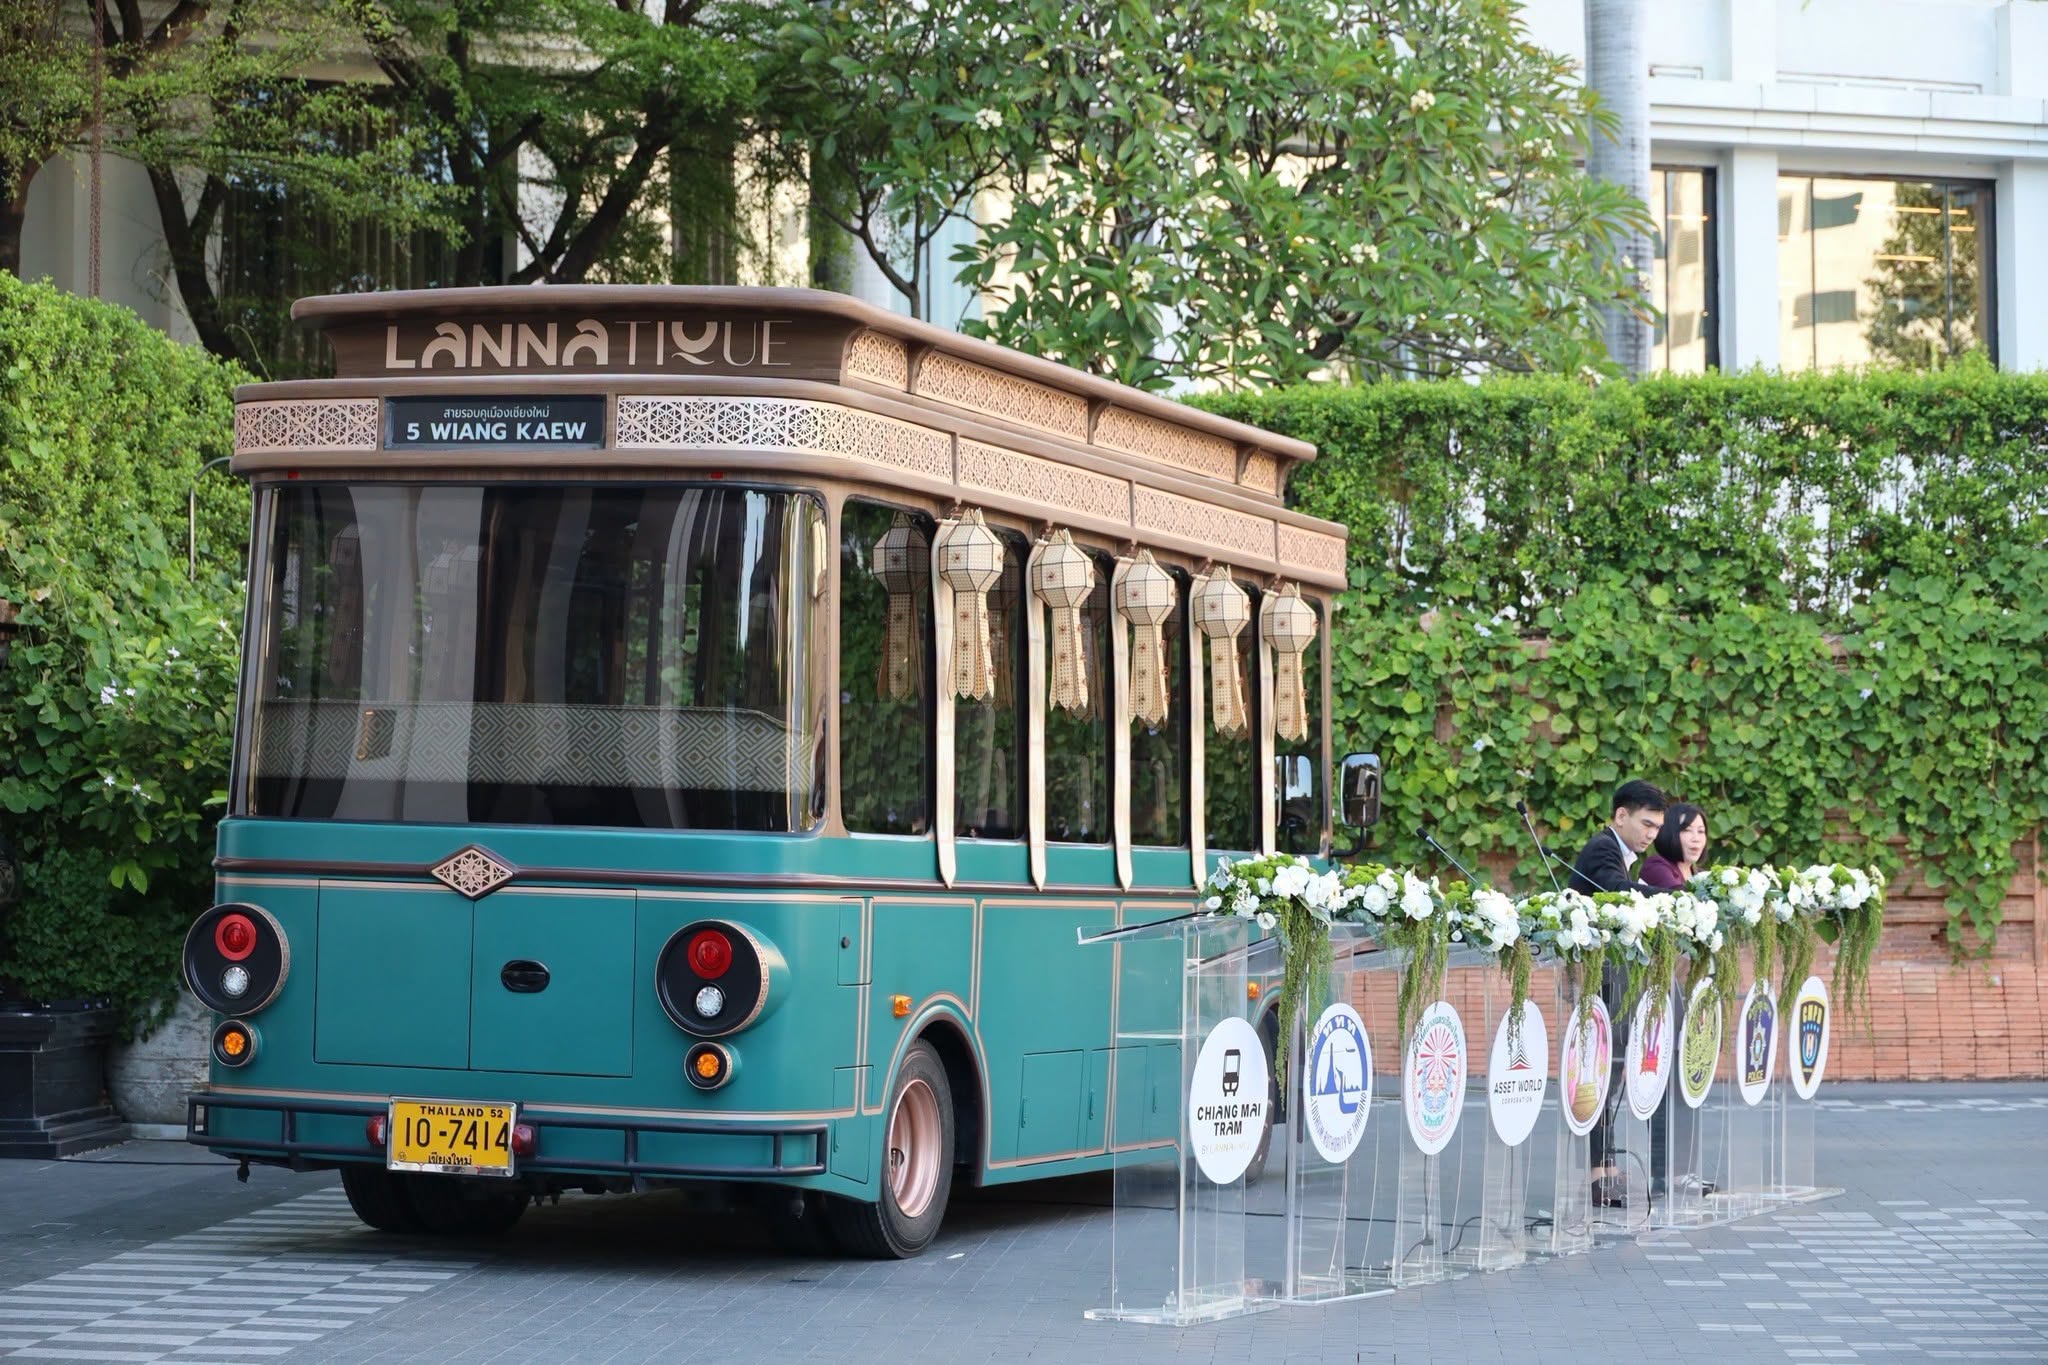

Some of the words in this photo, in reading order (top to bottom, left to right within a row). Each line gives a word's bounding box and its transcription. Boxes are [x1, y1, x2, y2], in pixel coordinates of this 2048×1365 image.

[443, 405, 550, 422] สายรอบคูเมืองเชียงใหม่
[406, 422, 420, 441] 5
[430, 422, 508, 441] WIANG
[516, 422, 587, 441] KAEW
[1493, 1080, 1517, 1094] ASSET
[1518, 1078, 1543, 1093] WORLD
[420, 1105, 484, 1118] THAILAND
[490, 1108, 504, 1119] 52
[1197, 1104, 1238, 1121] CHIANG
[1240, 1103, 1261, 1118] MAI
[405, 1116, 509, 1152] 10-7414
[1213, 1120, 1243, 1137] TRAM
[428, 1151, 472, 1166] เชียงใหม่
